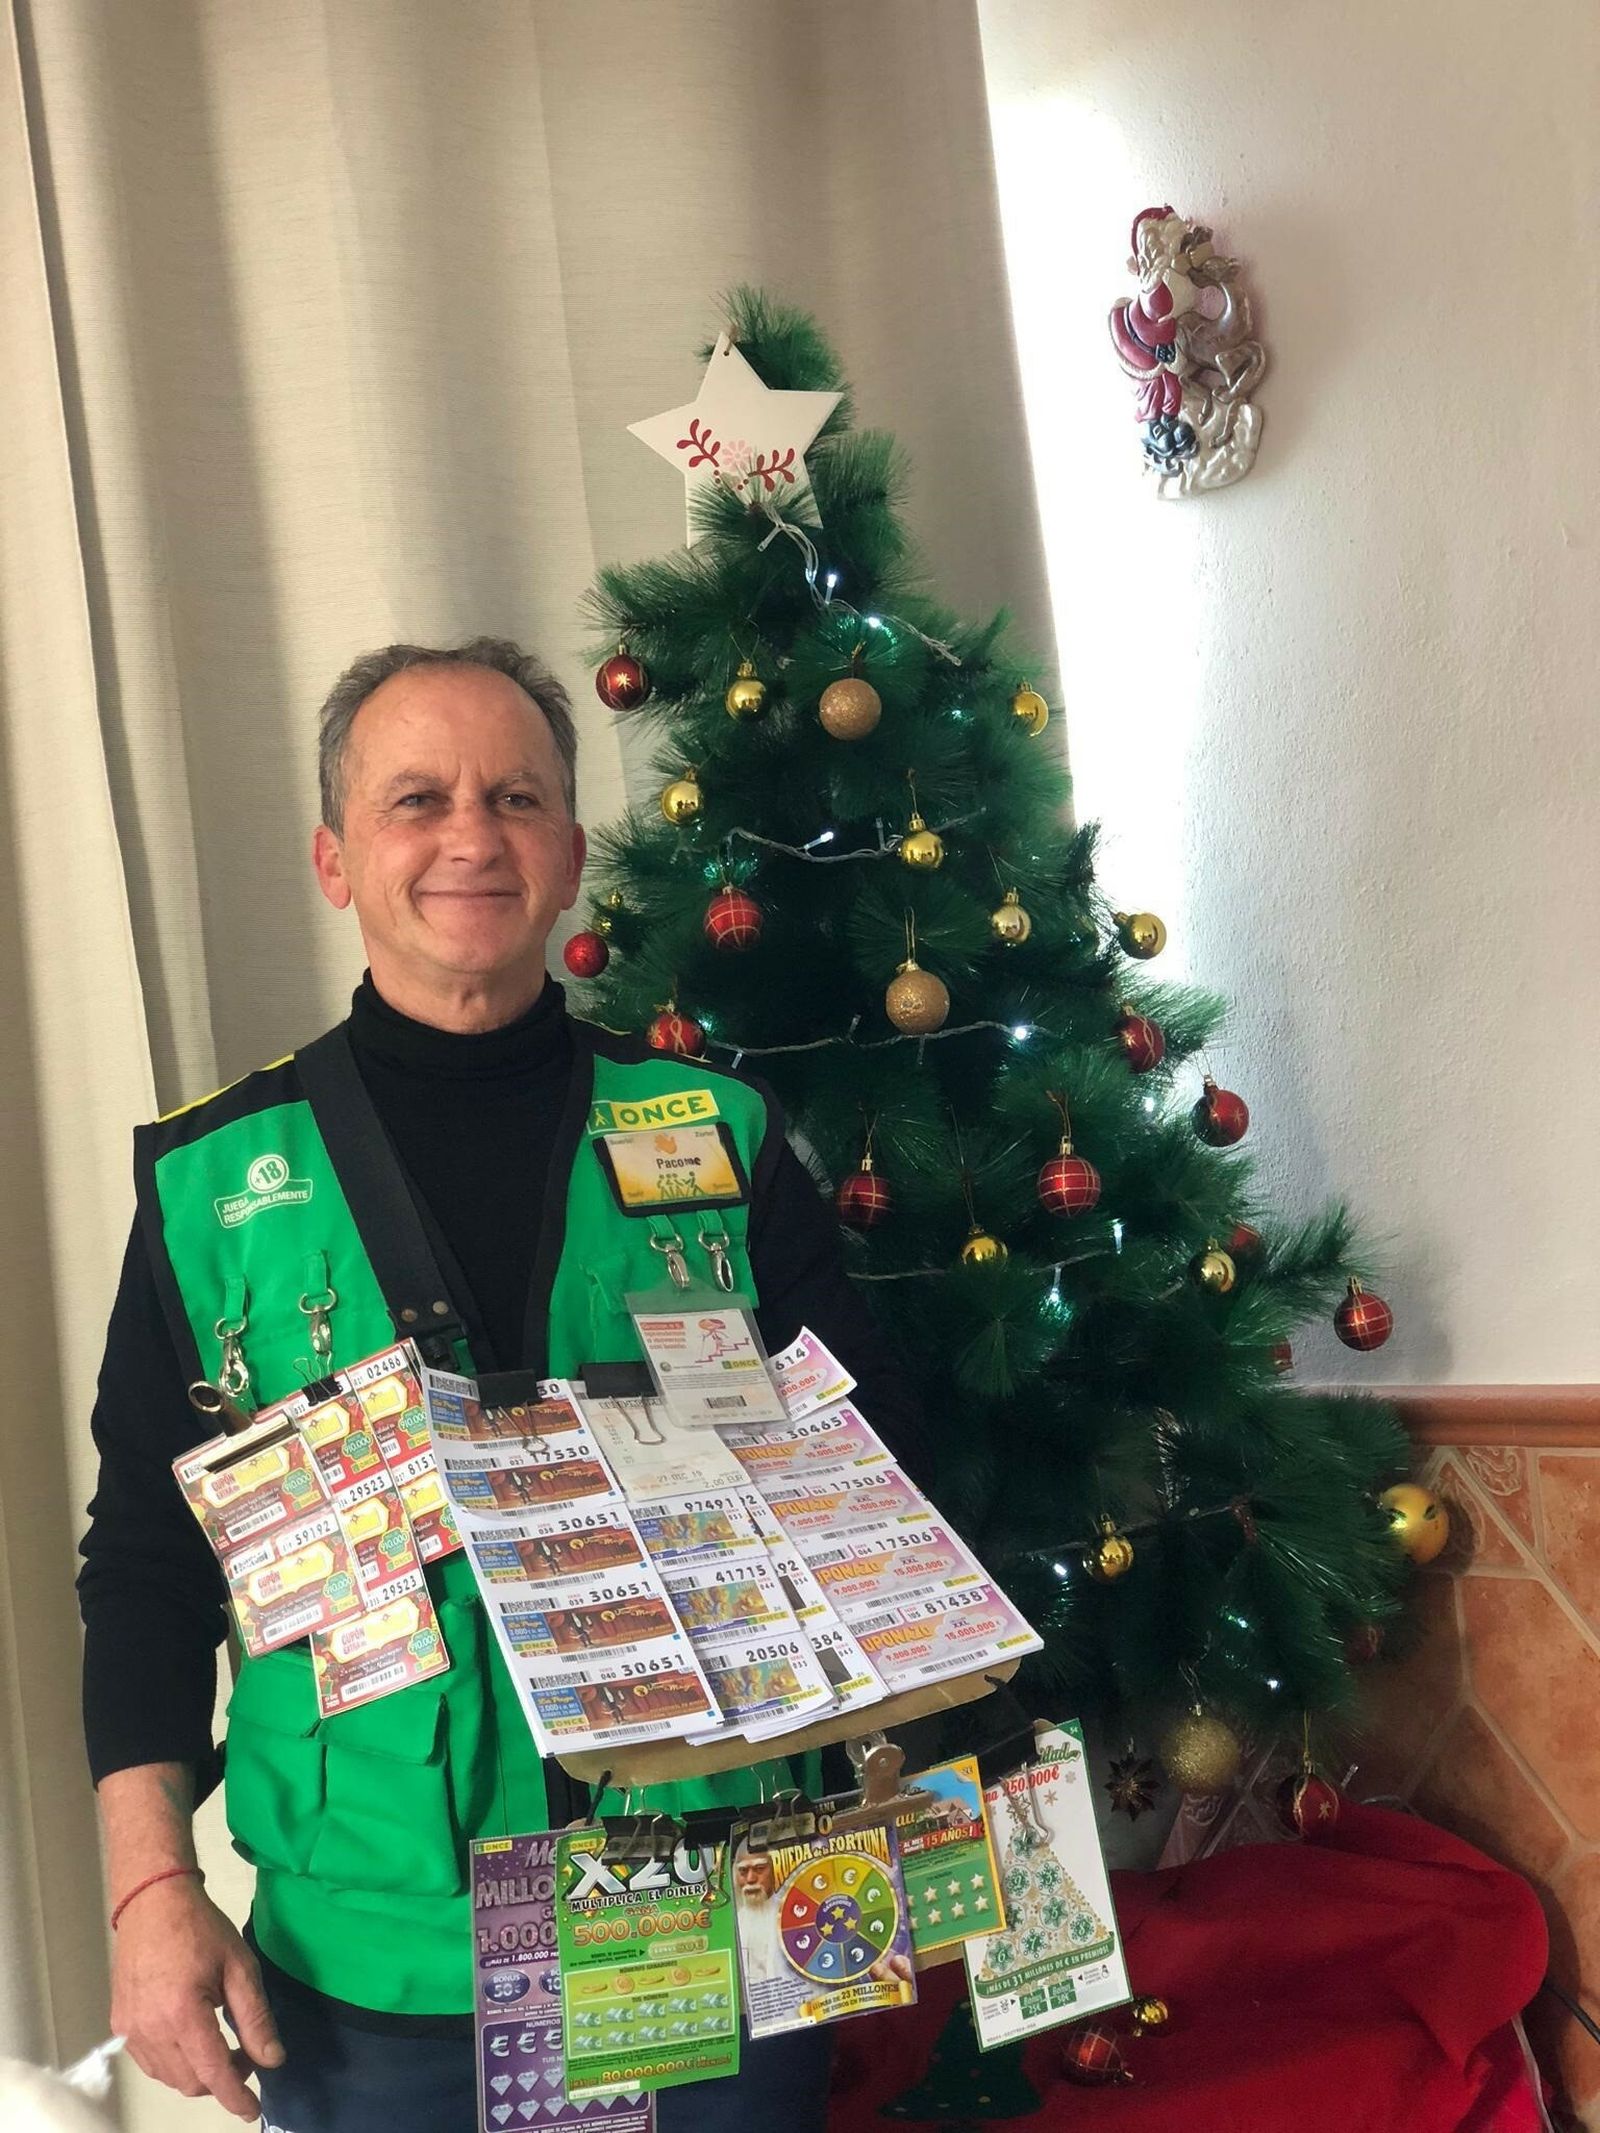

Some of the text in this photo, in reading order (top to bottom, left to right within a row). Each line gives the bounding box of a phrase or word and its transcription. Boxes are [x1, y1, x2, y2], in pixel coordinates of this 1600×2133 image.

[620, 1096, 708, 1125] ONCE
[224, 1189, 308, 1224] RESPONSABLEMENTE
[366, 1355, 402, 1380] 02486
[787, 1416, 843, 1440] 30465
[529, 1445, 590, 1464] 17530
[350, 1476, 386, 1502] 29523
[728, 1475, 744, 1485] EUR
[830, 1474, 887, 1493] 17506
[684, 1498, 735, 1513] 97491
[558, 1511, 621, 1532] 30651
[295, 1520, 331, 1546] 59192
[875, 1531, 933, 1552] 17506
[893, 1559, 945, 1577] 15.000.000
[901, 1556, 919, 1566] XXL
[495, 1569, 523, 1577] ONCE
[715, 1565, 767, 1583] 41715
[382, 1575, 417, 1601] 29523
[589, 1581, 653, 1603] 30651
[833, 1579, 877, 1595] 9.000.000
[924, 1589, 985, 1616] 81438
[944, 1620, 997, 1641] 15.000.000
[951, 1619, 970, 1629] XXL
[523, 1641, 556, 1650] ONCE
[746, 1642, 799, 1663] 20506
[885, 1643, 929, 1663] 9.000.000
[600, 1654, 686, 1681] 040 30651
[842, 1676, 872, 1693] ONCE
[556, 1718, 586, 1728] ONCE
[485, 1842, 511, 1852] ONCE
[571, 1841, 594, 1852] ONCE
[768, 1843, 814, 1895] RUEDA
[828, 1825, 894, 1868] FORTUNA
[475, 1874, 556, 1910] MILLO
[570, 1891, 642, 1913] MULTIPLICA
[648, 1889, 662, 1901] EL
[623, 1903, 660, 1917] GANA
[477, 1920, 557, 1954] 1.000
[573, 1908, 712, 1947] 500.000€
[511, 1950, 549, 1962] 1.800.000
[1003, 1979, 1012, 1989] DE
[1013, 1974, 1025, 1988] 31
[1024, 1962, 1050, 1982] MILLONES
[1050, 1959, 1064, 1971] DE
[1080, 1944, 1111, 1963] PREMIOS!
[492, 1973, 521, 1984] BONUS
[493, 1983, 522, 1998] 50€
[841, 1990, 852, 2000] 23
[852, 1982, 900, 1998] MILLONES
